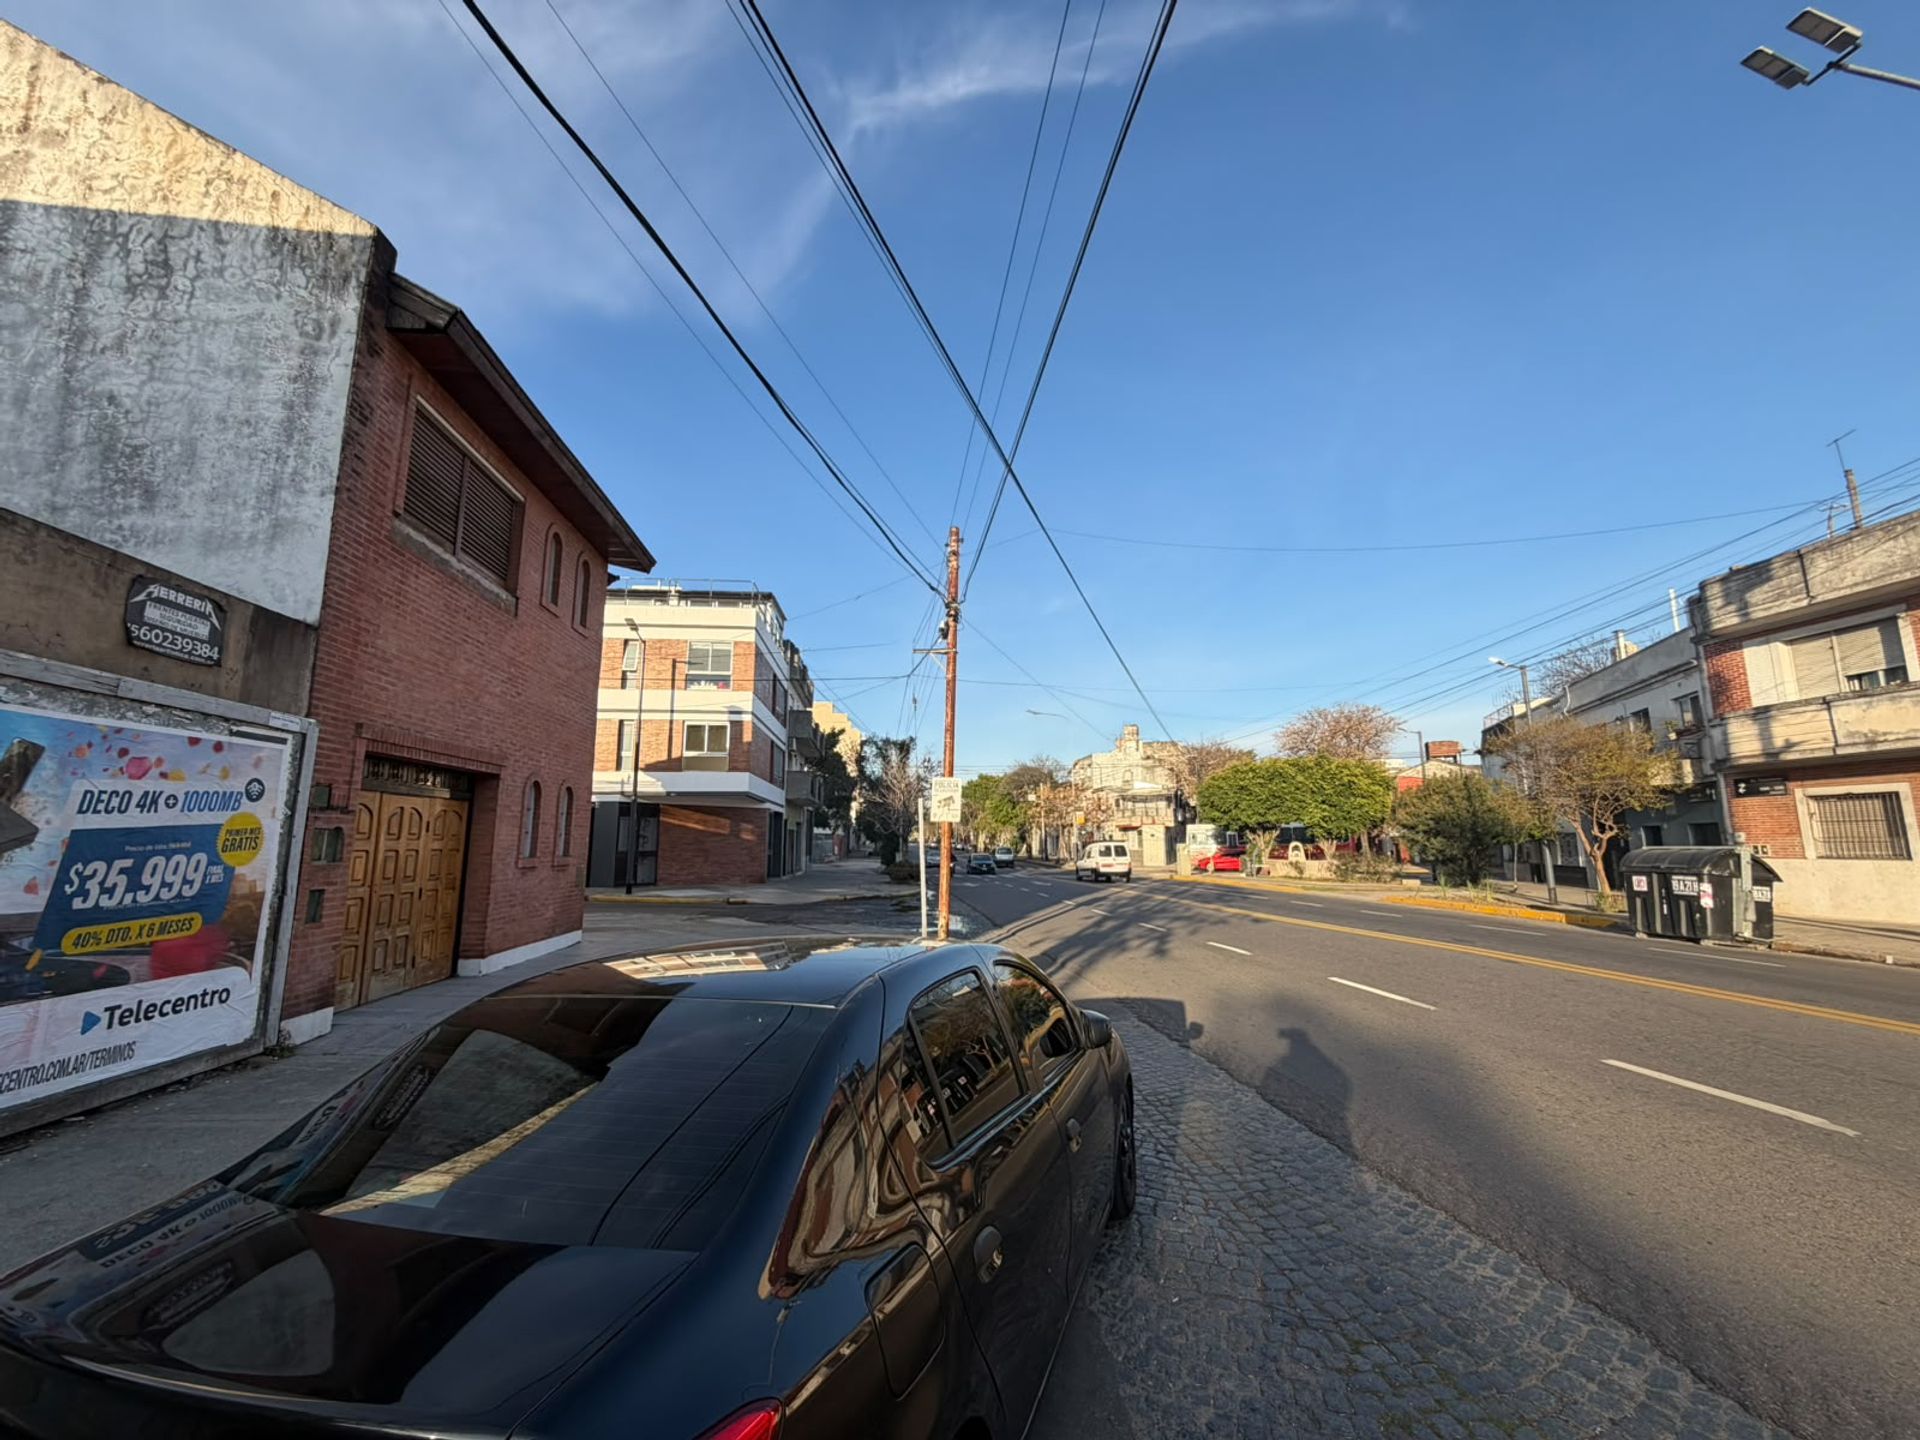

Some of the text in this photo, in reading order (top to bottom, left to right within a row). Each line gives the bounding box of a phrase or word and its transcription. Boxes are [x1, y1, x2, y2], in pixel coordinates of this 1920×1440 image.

[127, 623, 220, 660] 560239384
[77, 790, 132, 814] DECO
[135, 790, 164, 814] 4K
[180, 790, 244, 813] 1000MB
[221, 836, 260, 853] GRATIS
[64, 852, 208, 910] $35.999
[72, 917, 194, 949] 40% DTO. X 6 MESES
[103, 987, 230, 1030] Telecentro
